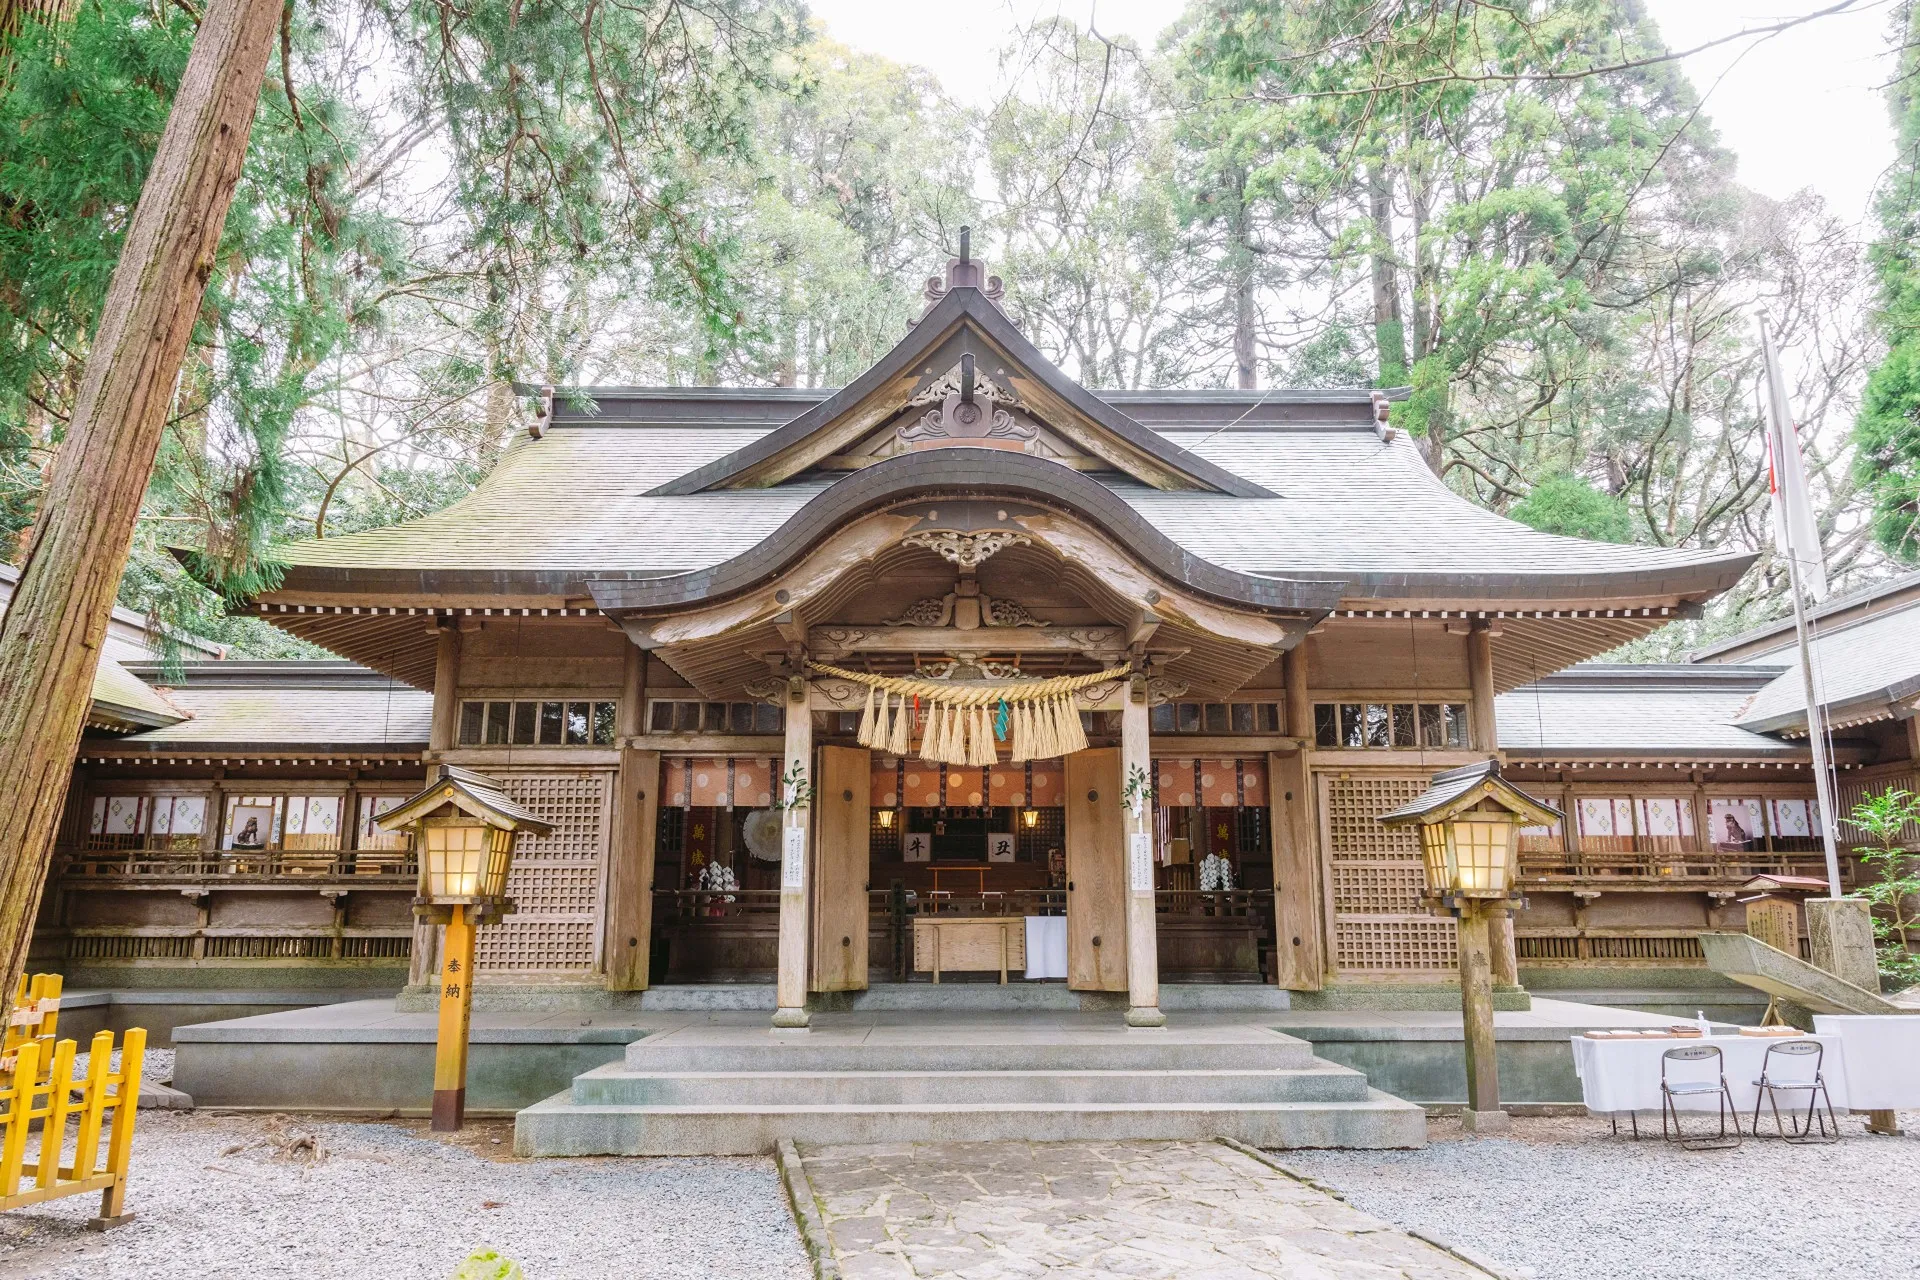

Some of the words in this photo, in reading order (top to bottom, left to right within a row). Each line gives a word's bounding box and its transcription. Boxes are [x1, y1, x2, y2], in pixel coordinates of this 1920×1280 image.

[909, 837, 925, 858] 牛
[995, 840, 1011, 856] 丑
[445, 957, 462, 999] 奉納
